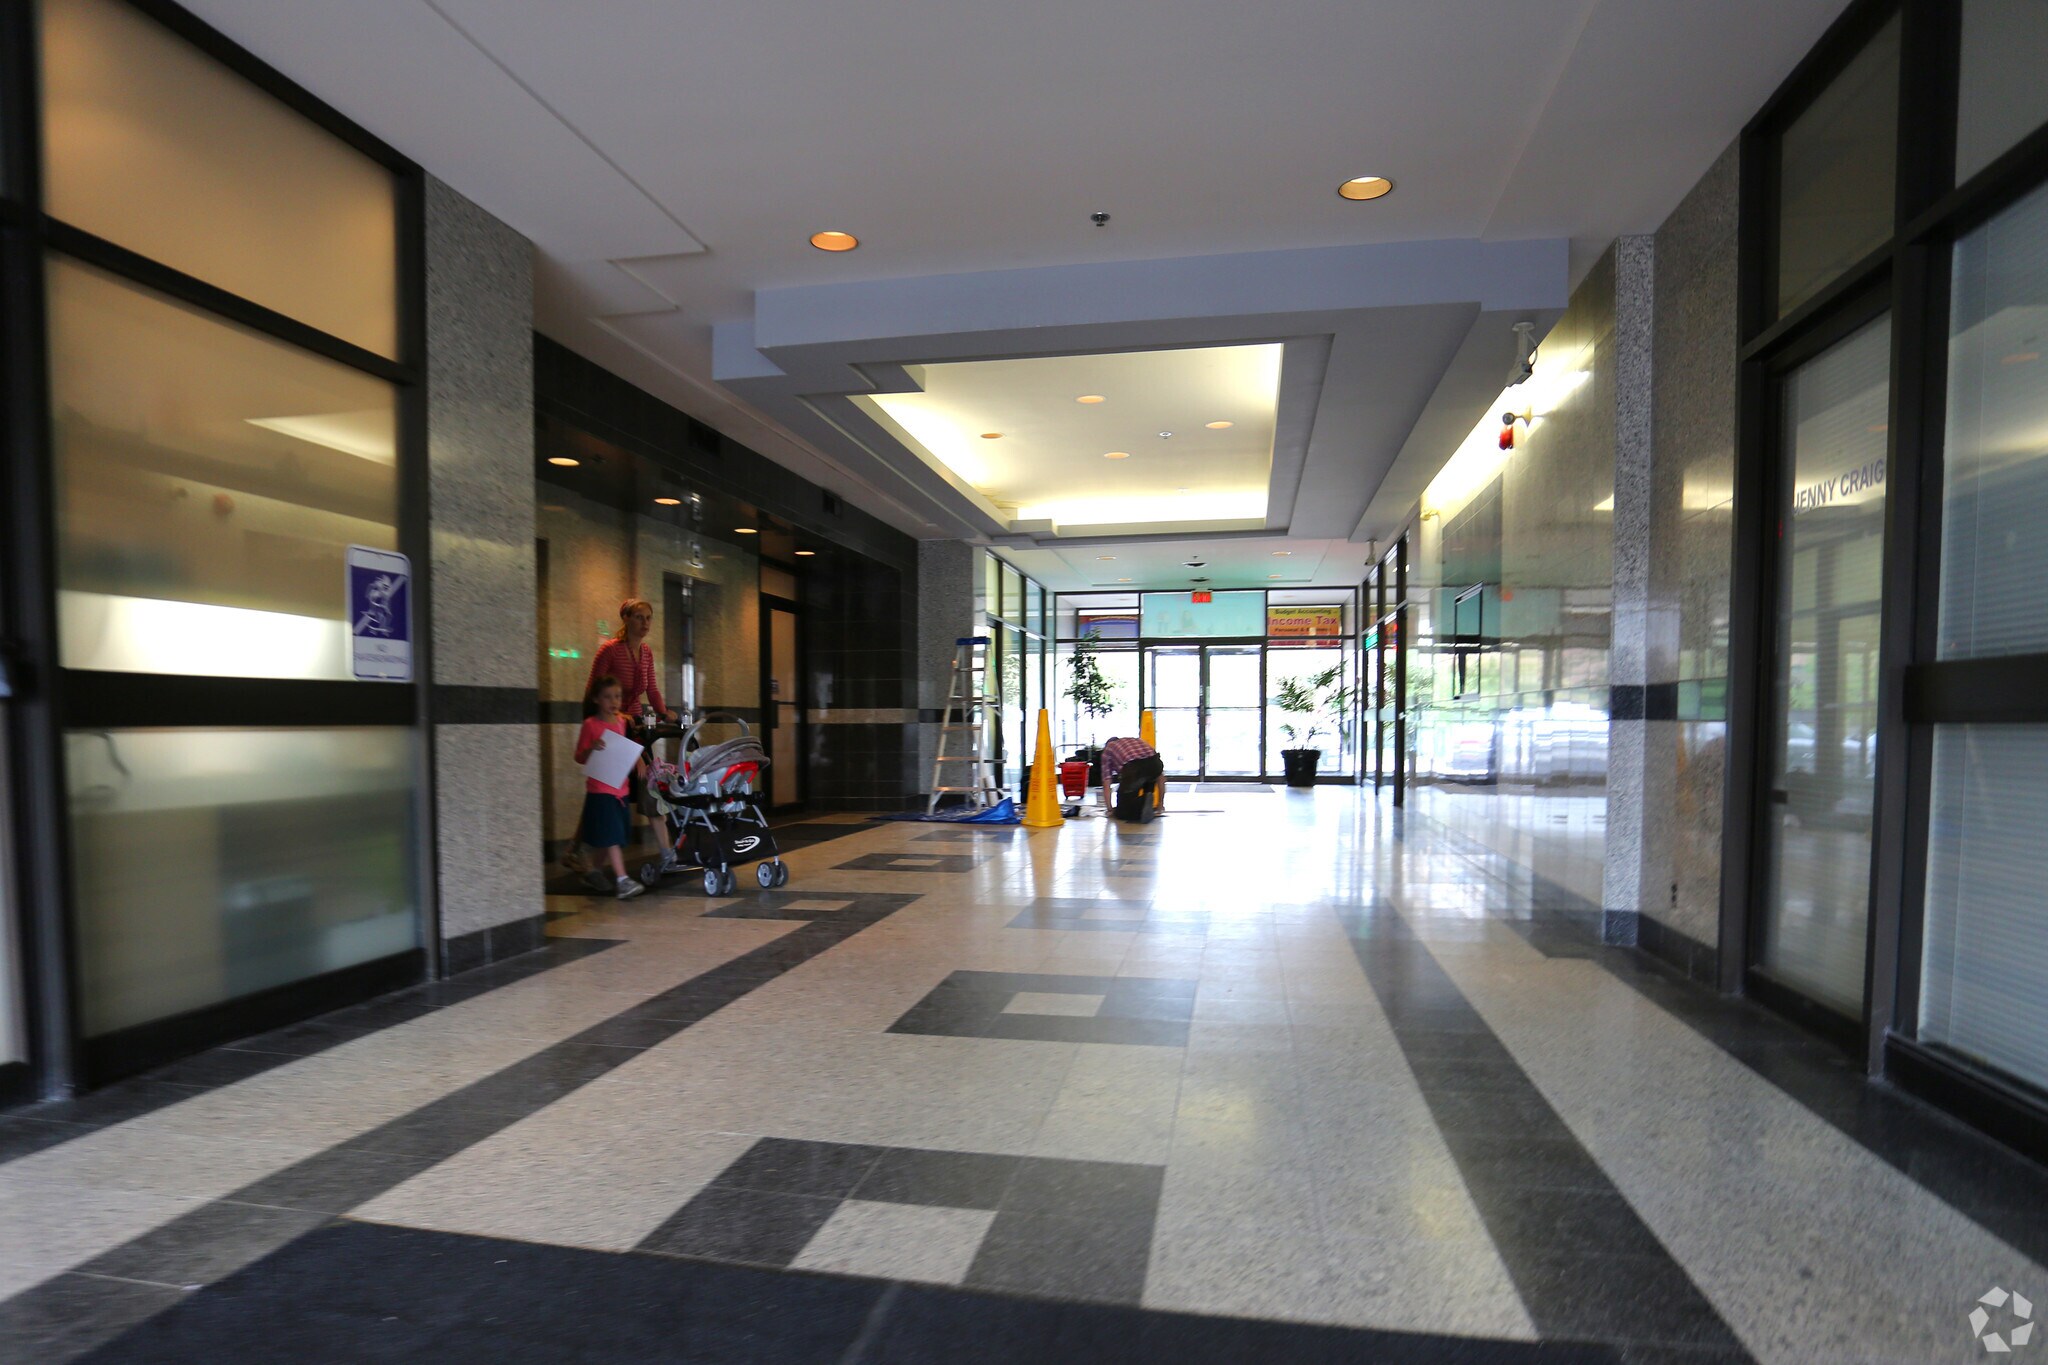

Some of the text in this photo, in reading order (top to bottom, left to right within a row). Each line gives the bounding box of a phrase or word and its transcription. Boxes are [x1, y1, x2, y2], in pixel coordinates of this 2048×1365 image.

[1793, 459, 1884, 514] JENNY CRAIG
[1268, 615, 1337, 625] Income Tax
